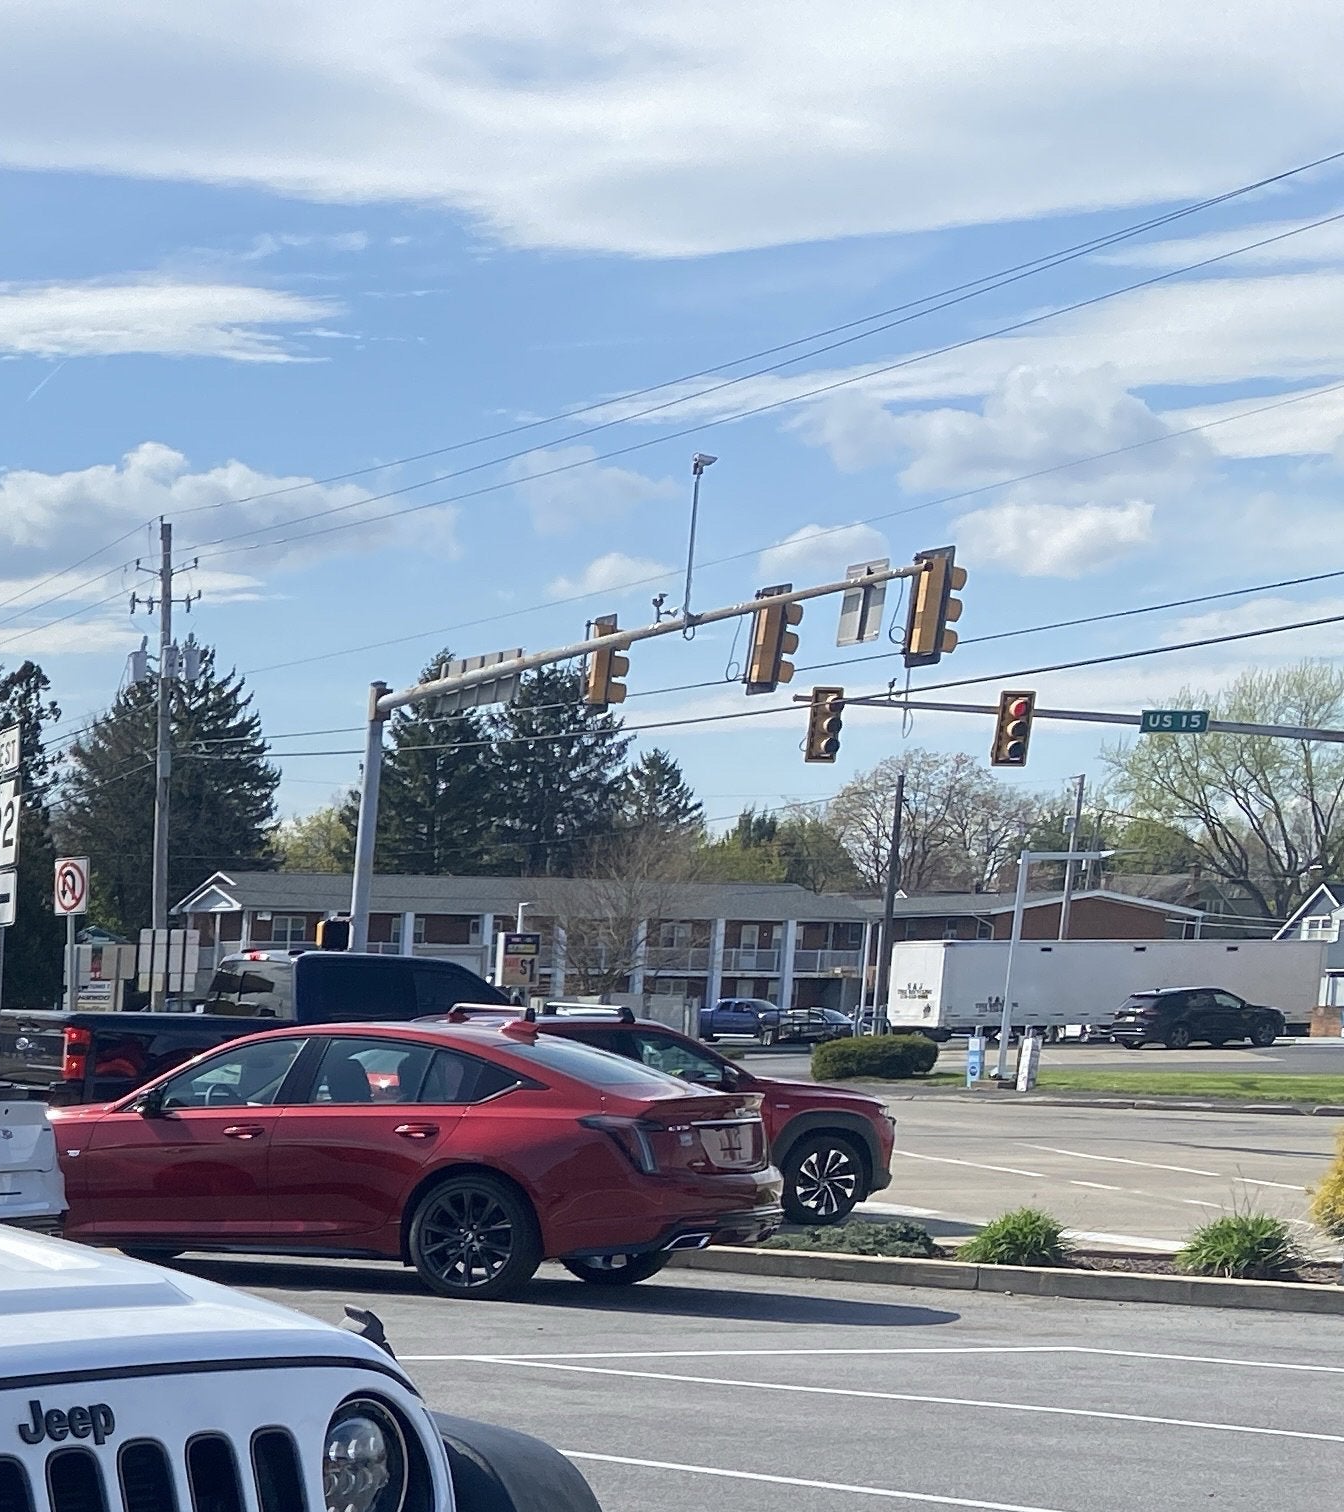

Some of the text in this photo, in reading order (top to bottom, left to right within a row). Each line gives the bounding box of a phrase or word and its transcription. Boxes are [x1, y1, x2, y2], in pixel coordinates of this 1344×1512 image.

[1149, 714, 1202, 728] US 15
[18, 1400, 116, 1445] Jeep
